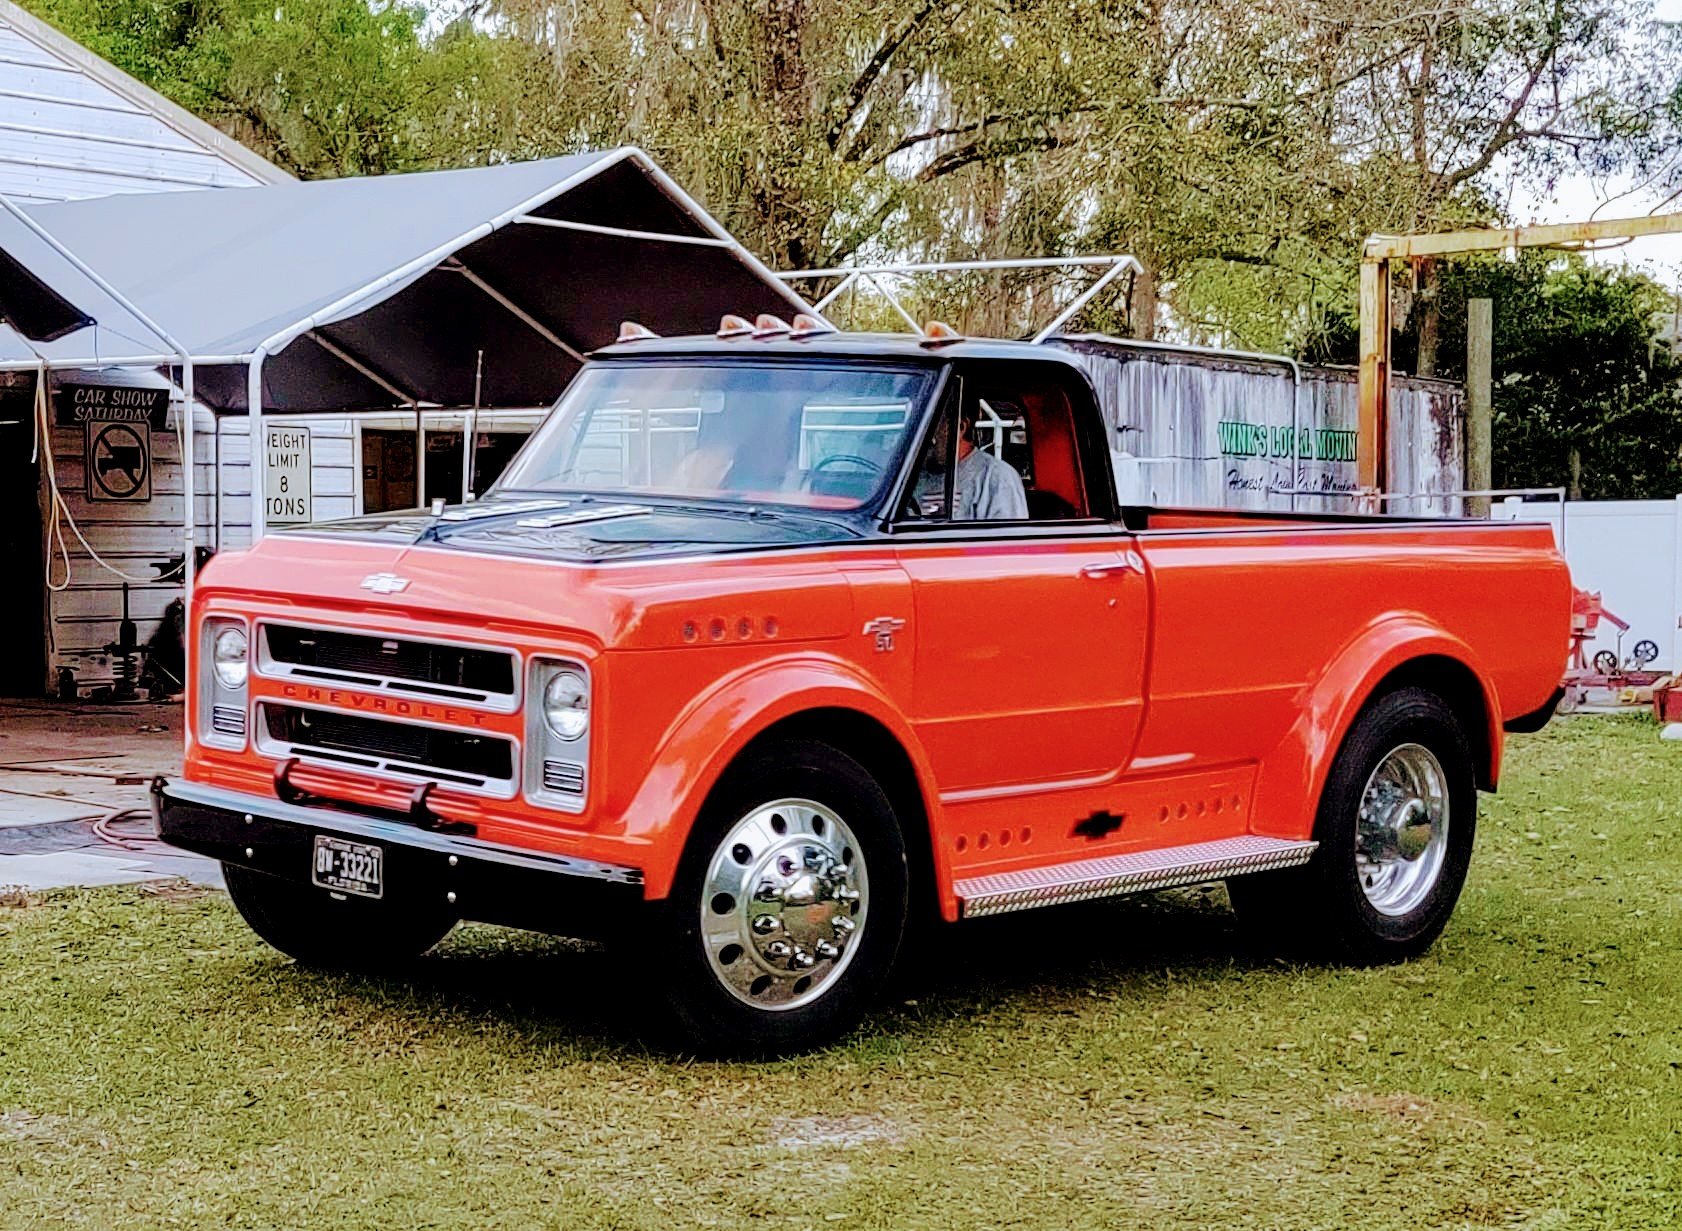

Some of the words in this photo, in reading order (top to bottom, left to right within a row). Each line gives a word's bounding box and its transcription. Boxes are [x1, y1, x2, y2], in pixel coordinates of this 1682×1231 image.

[74, 388, 106, 404] CAR
[110, 389, 158, 406] SHOW
[73, 405, 153, 421] SATURDAY
[1217, 421, 1267, 458] WINK'S
[1314, 428, 1359, 462] MOVIN
[268, 453, 300, 468] LIMIT
[280, 475, 289, 493] 8
[266, 497, 306, 516] TONS
[283, 684, 486, 726] CHEVROLET
